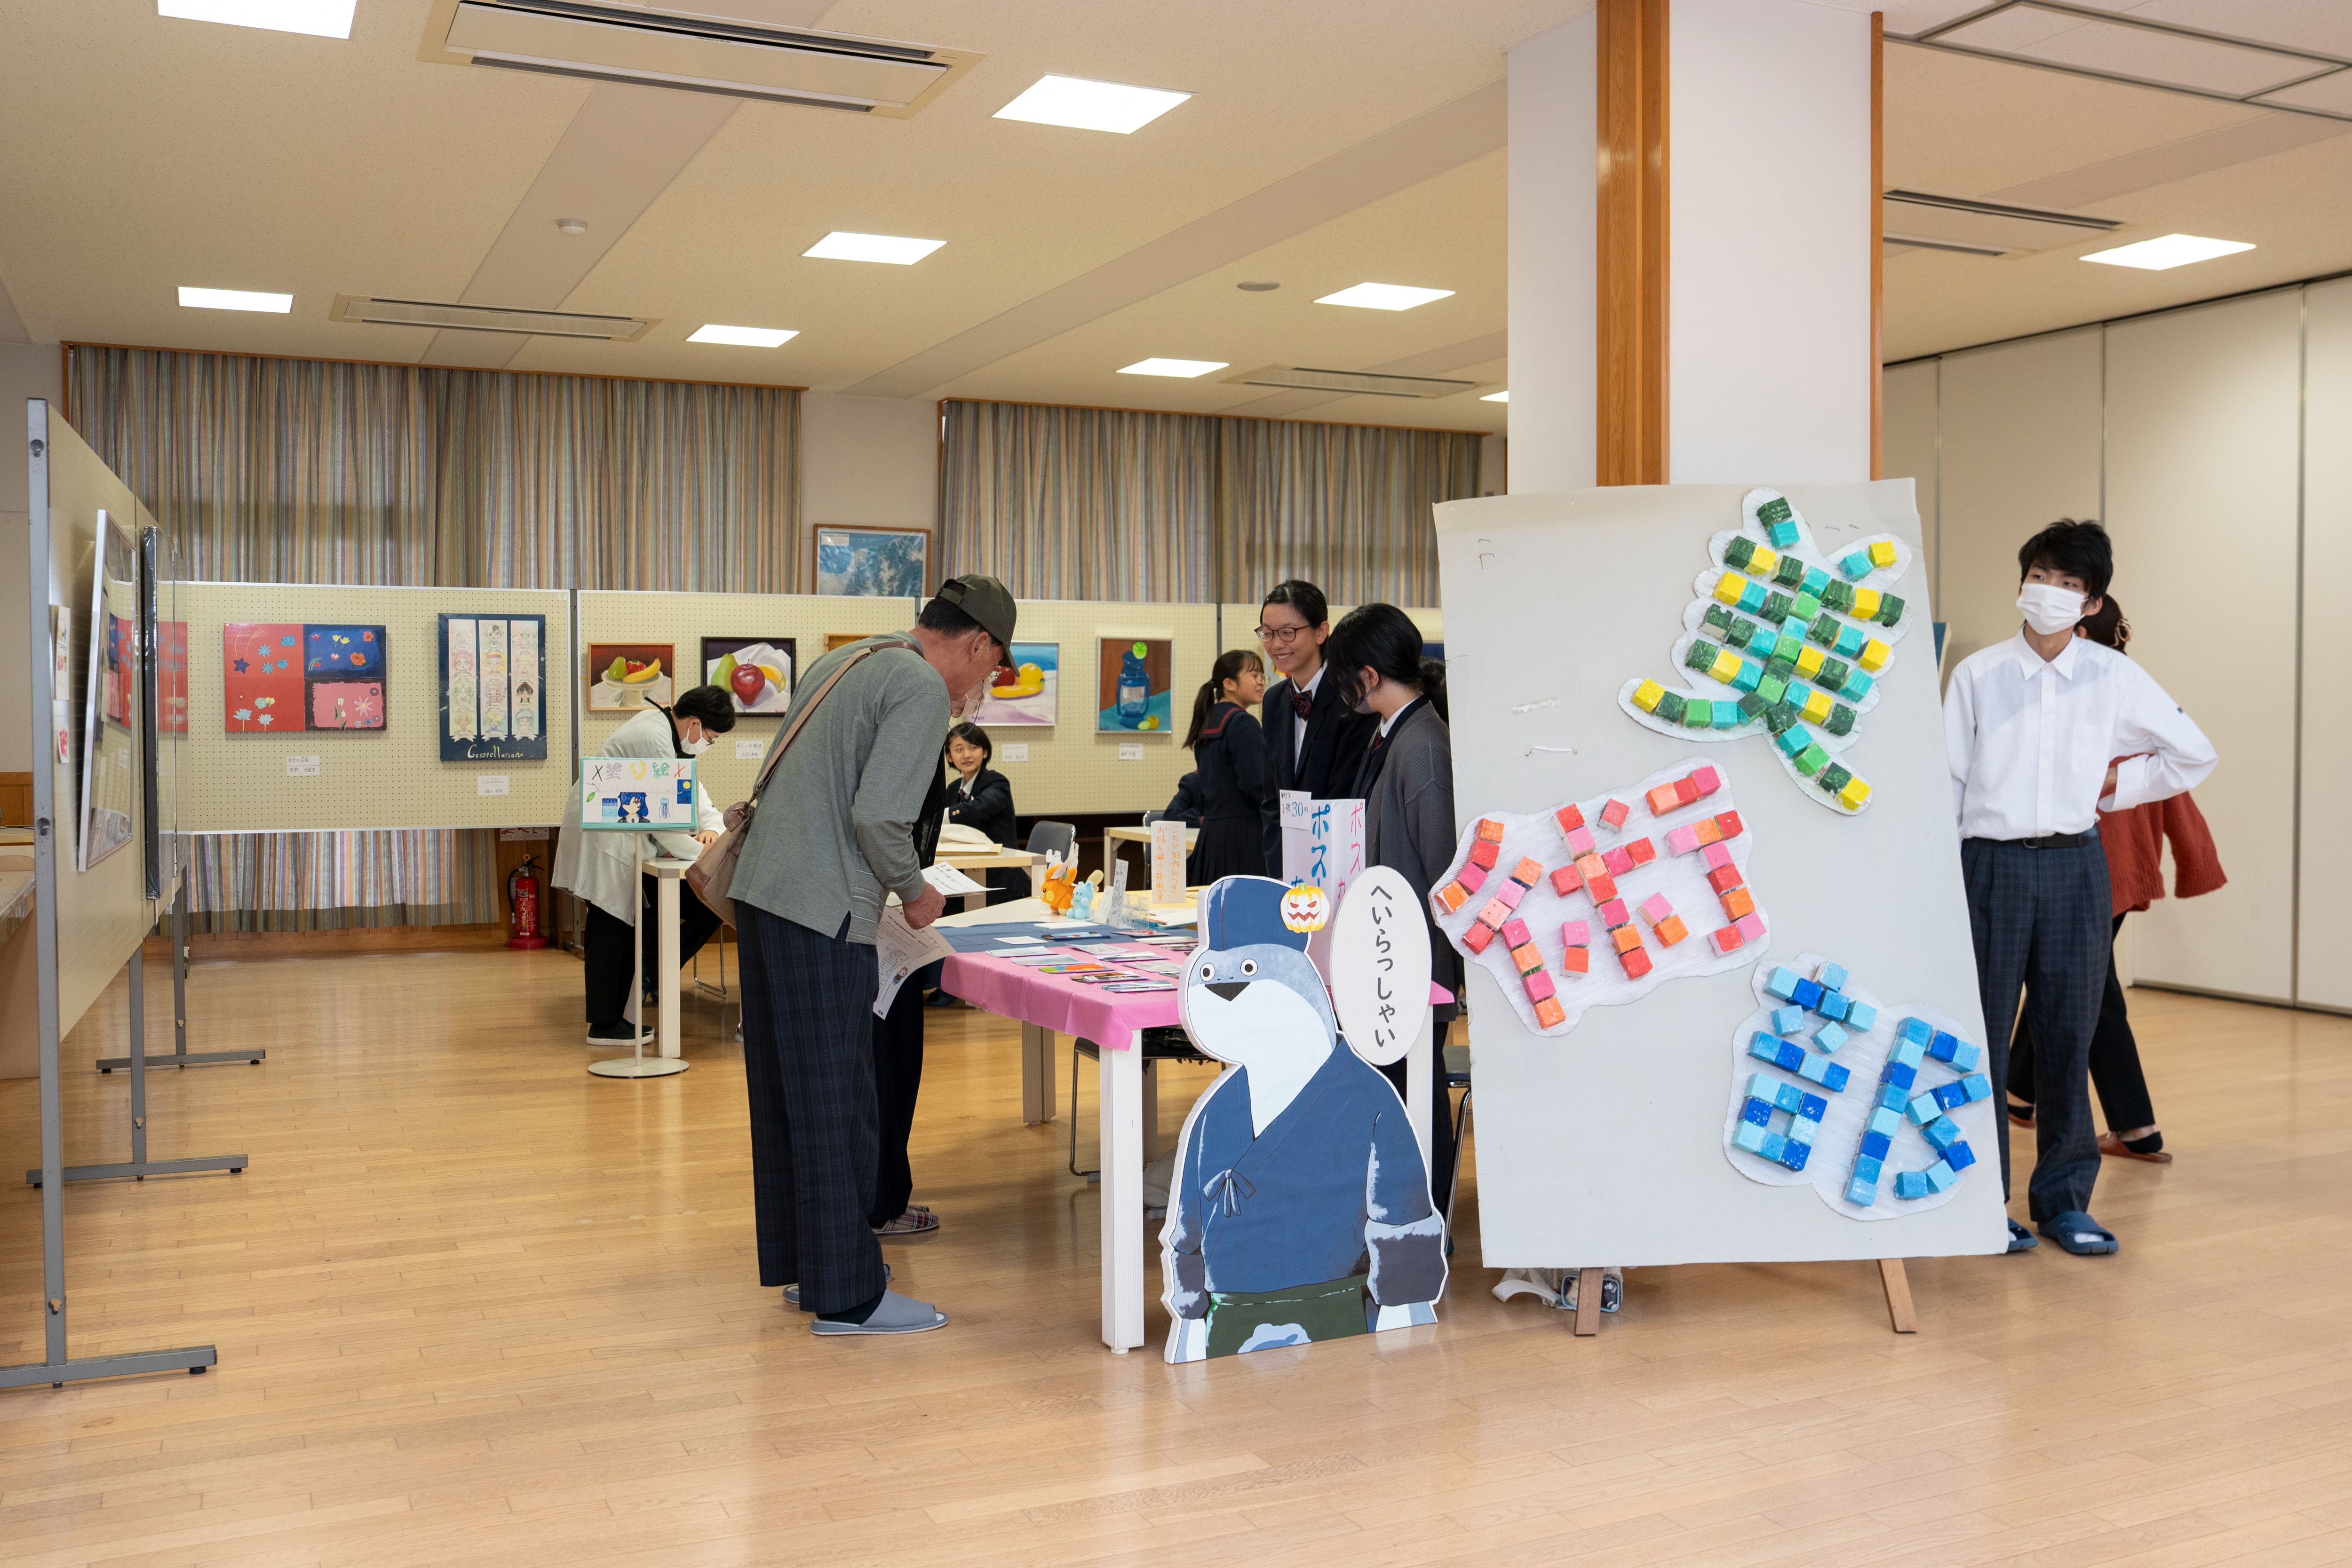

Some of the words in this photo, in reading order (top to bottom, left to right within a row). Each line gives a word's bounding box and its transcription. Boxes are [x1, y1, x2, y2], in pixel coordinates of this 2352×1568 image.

[606, 760, 670, 780] 塗り絵
[1282, 801, 1308, 817] 1枚30円
[1155, 826, 1168, 902] お持ち帰り自由です
[1370, 885, 1396, 1048] へいらっしゃい
